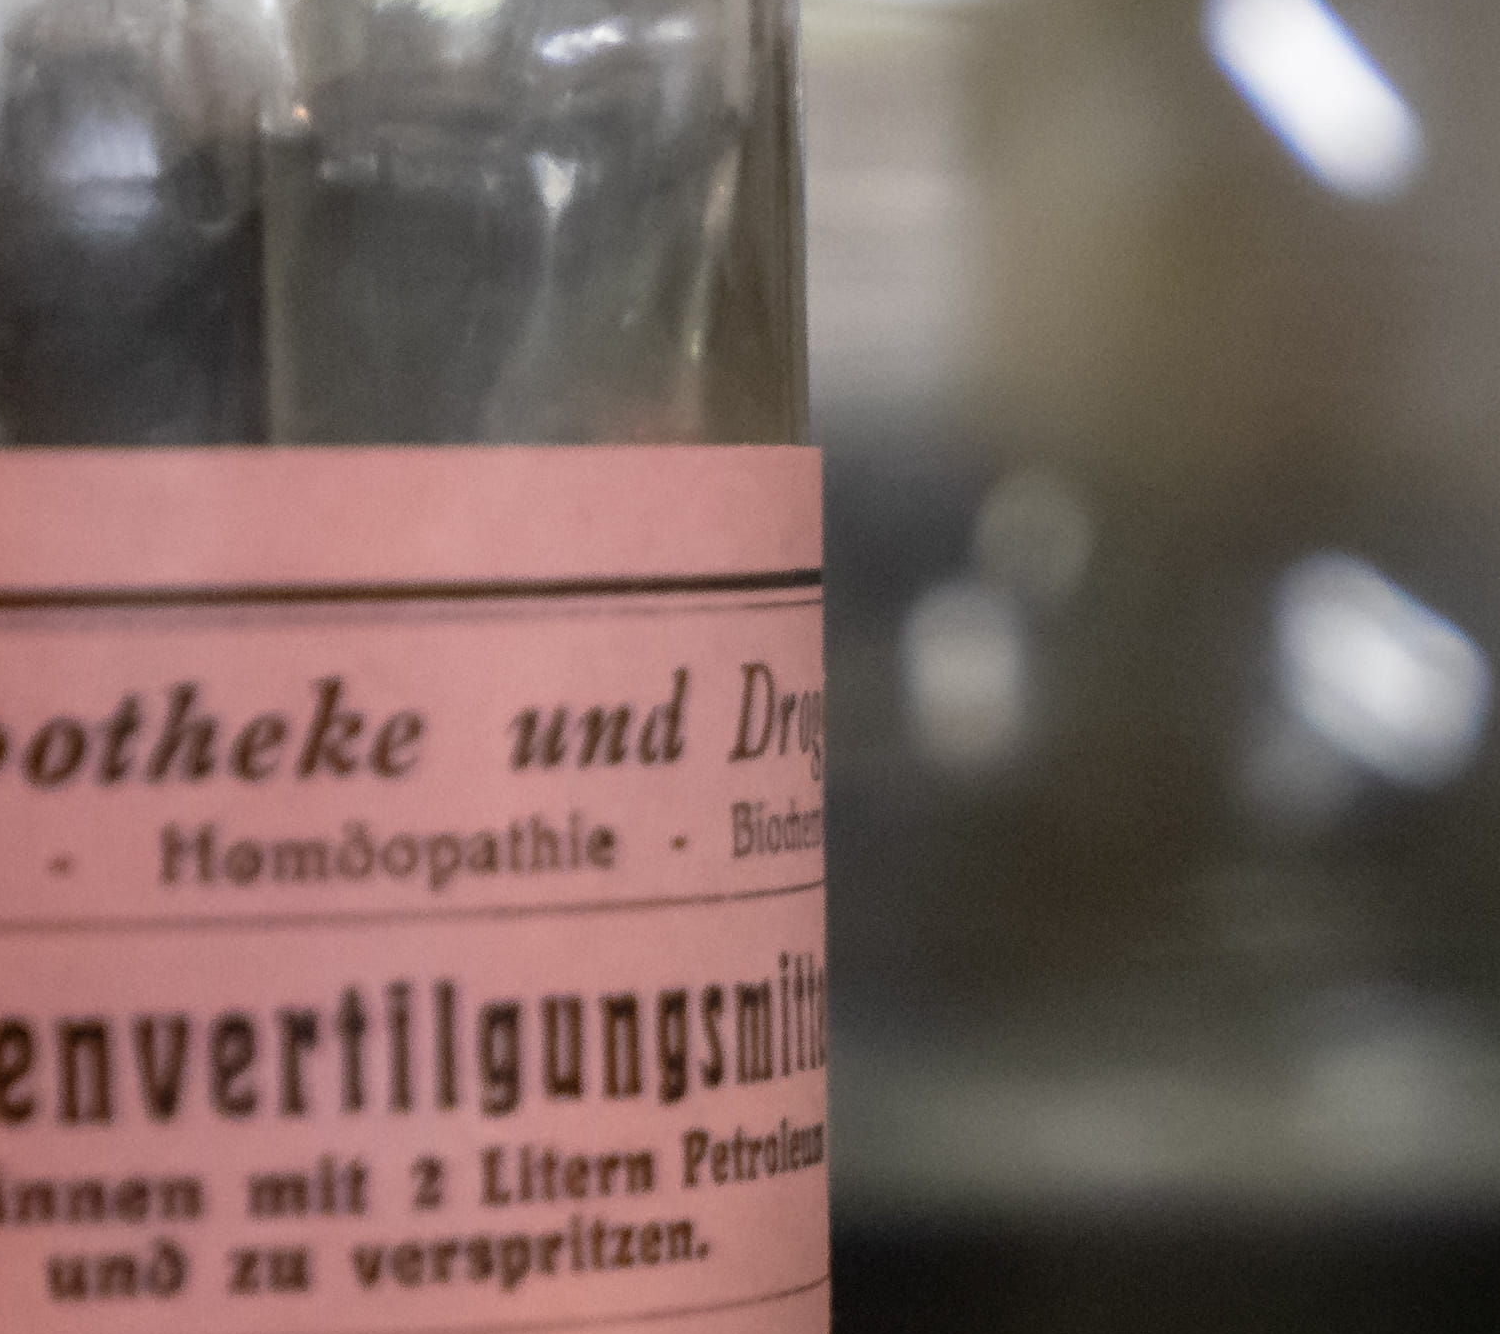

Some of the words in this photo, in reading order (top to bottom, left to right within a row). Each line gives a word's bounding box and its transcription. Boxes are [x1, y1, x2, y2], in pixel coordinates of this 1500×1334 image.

[508, 667, 692, 771] und
[158, 809, 618, 893] Homöopathie
[247, 1157, 370, 1219] mit
[412, 1157, 445, 1207] 2
[480, 1145, 657, 1207] Litern
[45, 1237, 190, 1301] und
[228, 1247, 311, 1295] zu
[350, 1215, 710, 1293] verspritzen.
